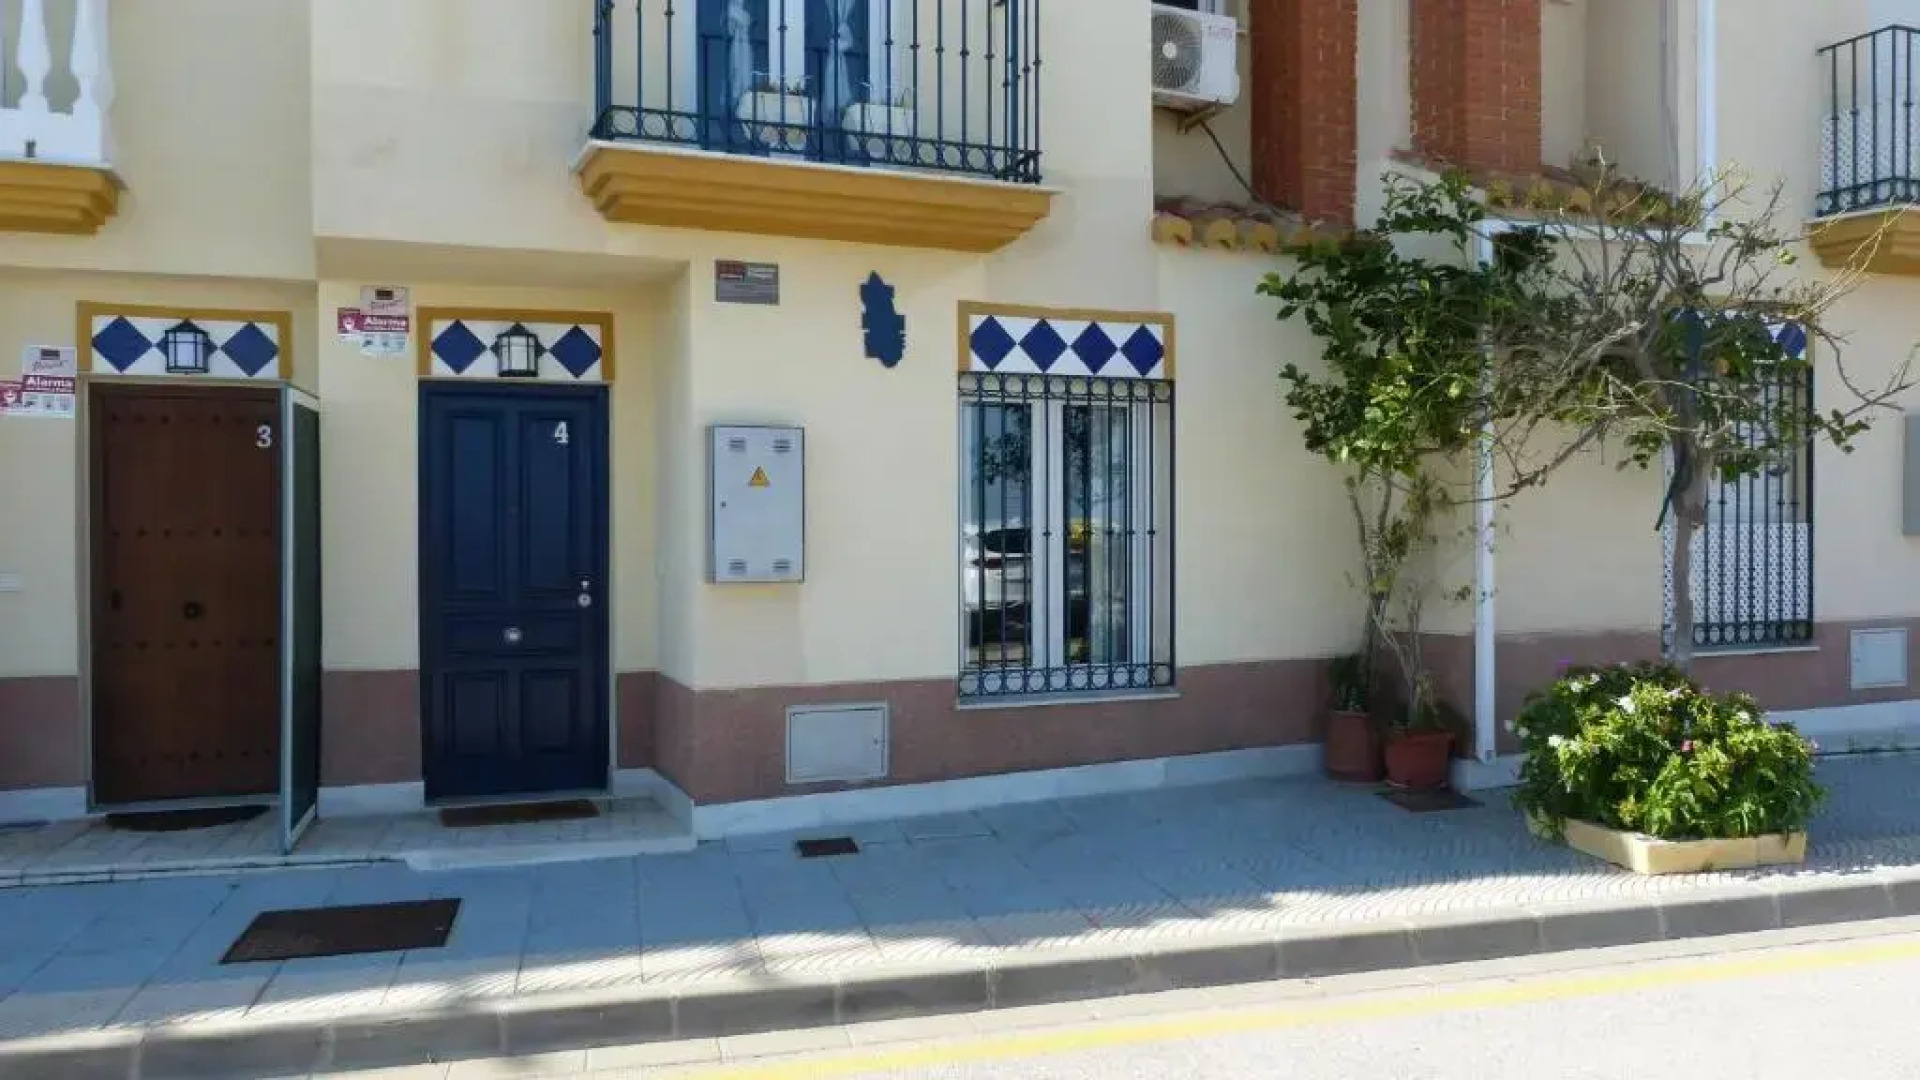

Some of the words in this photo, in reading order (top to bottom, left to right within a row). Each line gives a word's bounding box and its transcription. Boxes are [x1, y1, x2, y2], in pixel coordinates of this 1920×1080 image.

[364, 316, 406, 326] Alarma
[26, 376, 72, 387] Alarma
[256, 425, 271, 448] 3
[554, 421, 569, 443] 4
